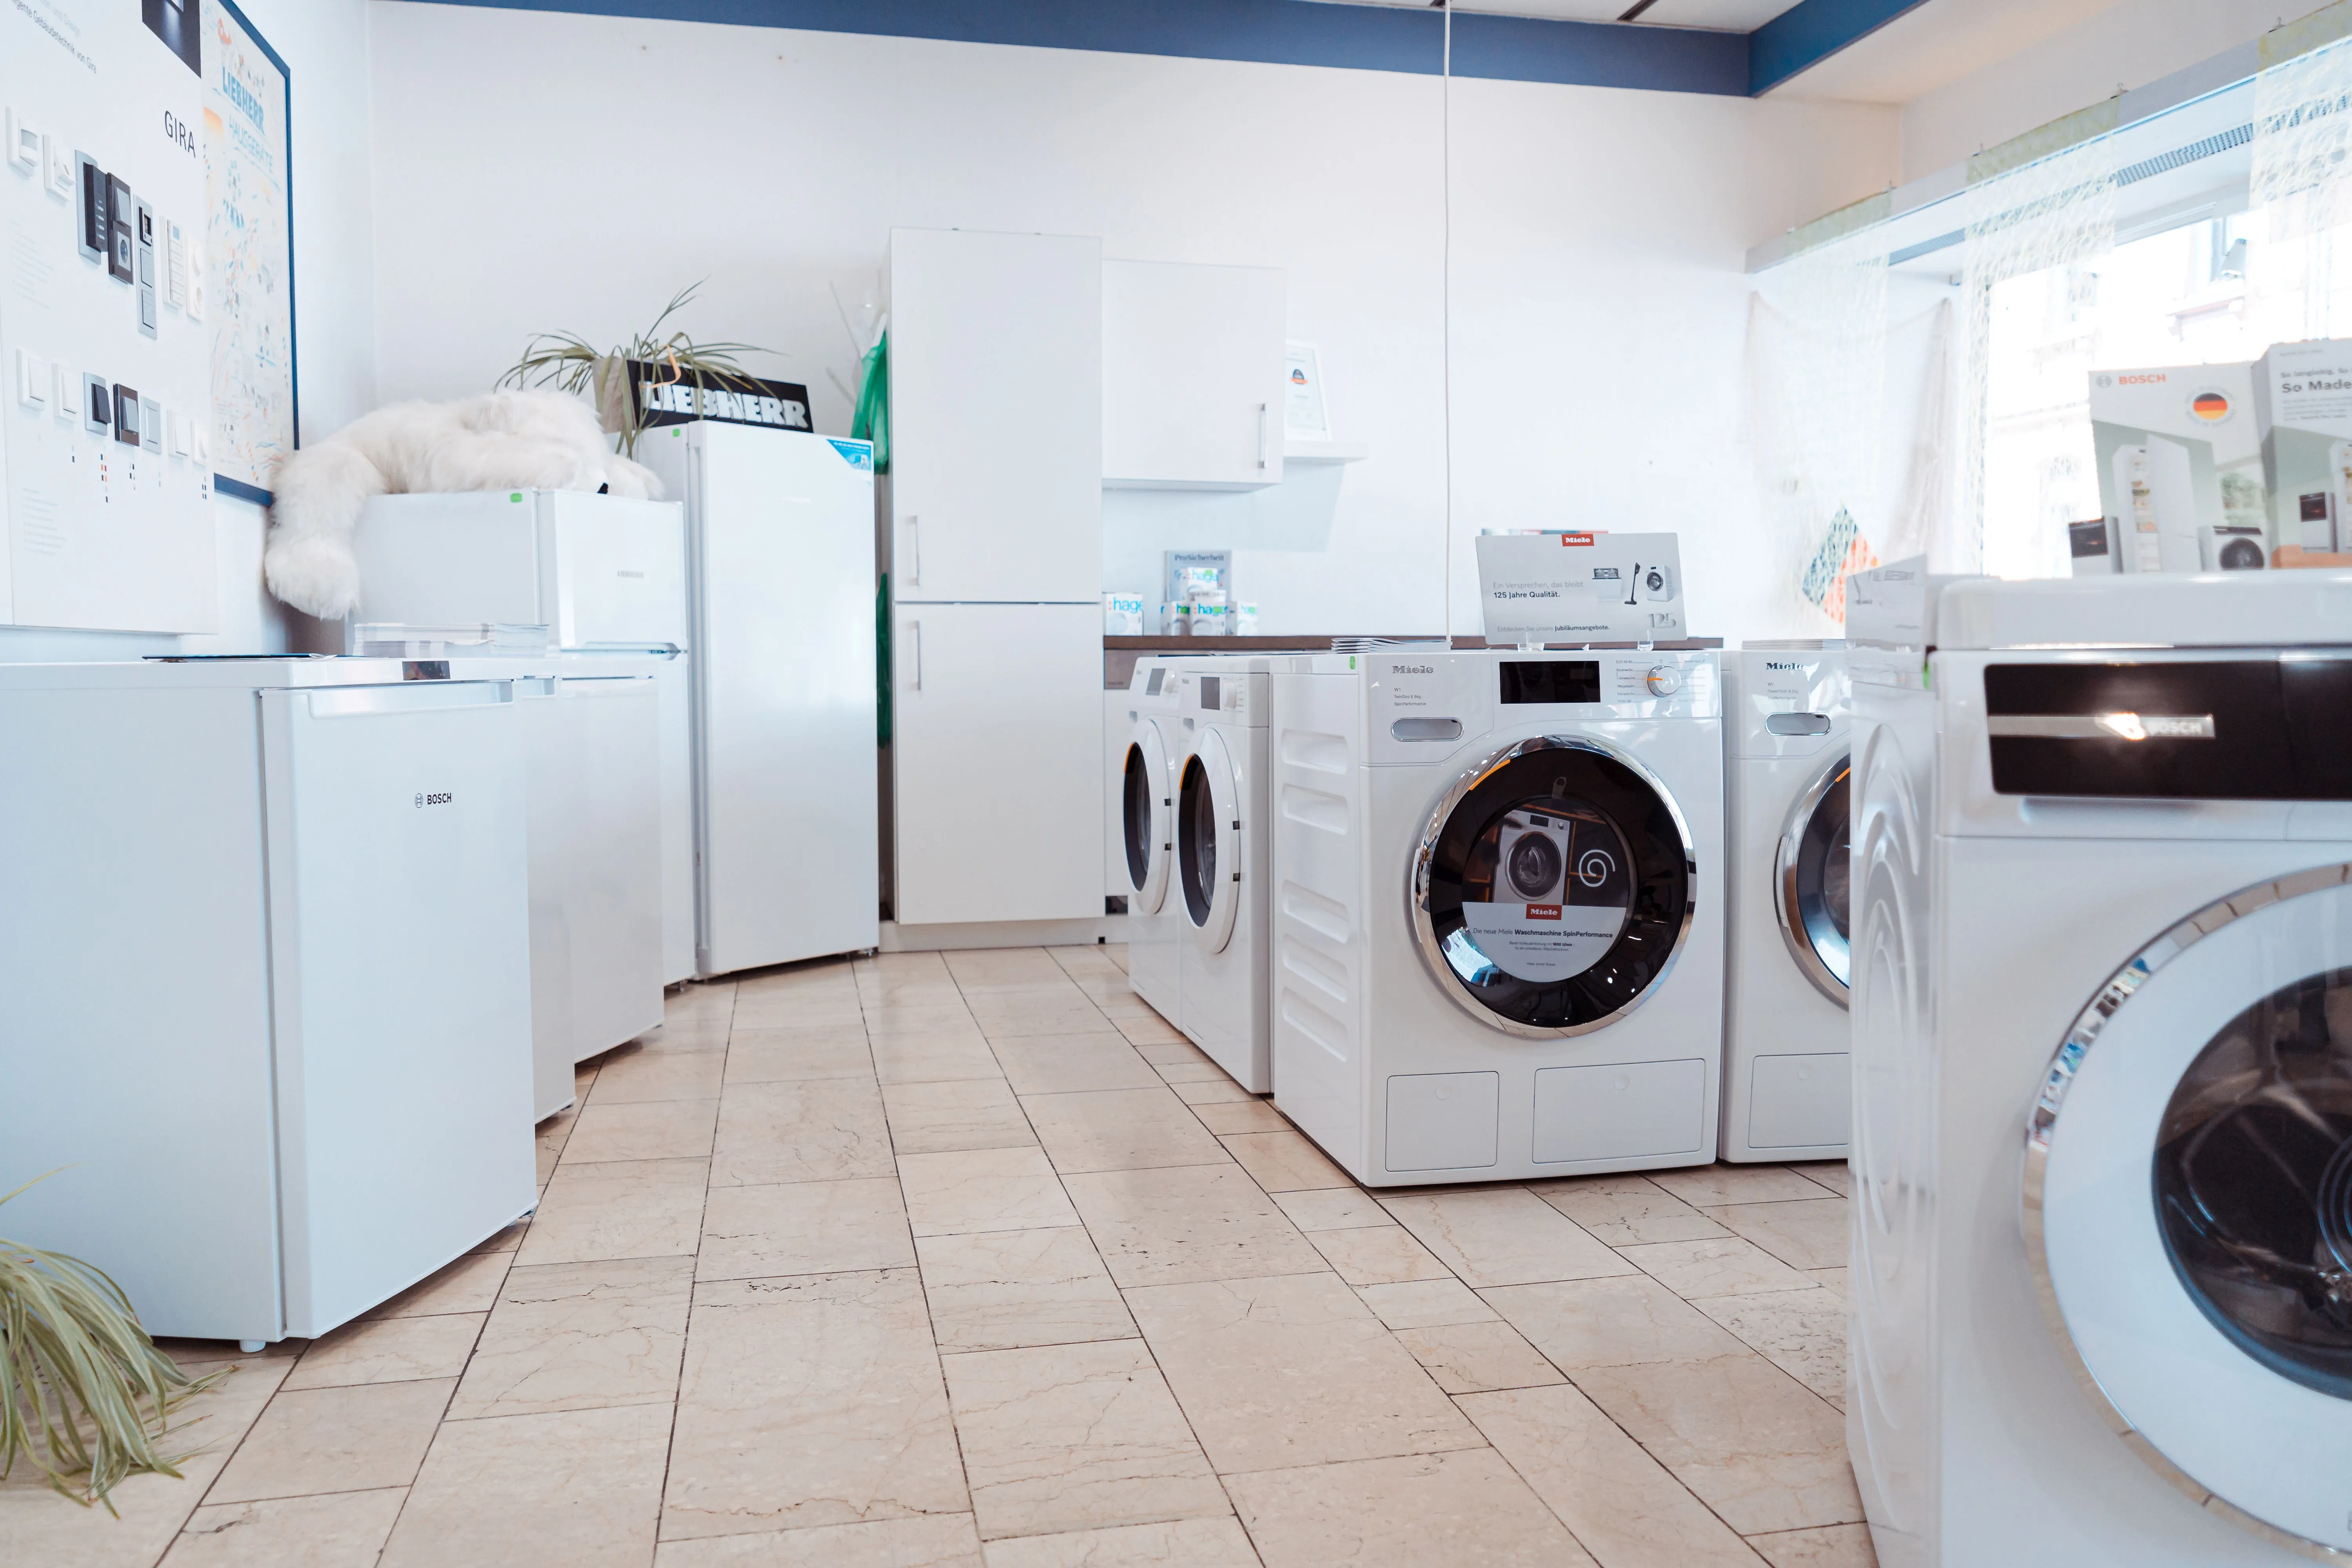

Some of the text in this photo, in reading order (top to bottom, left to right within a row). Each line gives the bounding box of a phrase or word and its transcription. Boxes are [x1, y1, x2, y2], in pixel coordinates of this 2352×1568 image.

[34, 11, 75, 55] Gebäudetechnik
[76, 50, 85, 65] von
[87, 56, 96, 74] Gira
[222, 66, 266, 136] LIEBHERR
[165, 111, 196, 158] GIRA
[2119, 374, 2166, 385] BOSCH
[2282, 379, 2352, 393] So Made
[639, 381, 808, 428] LIEBHERR
[1505, 581, 1549, 590] Versprechen,
[1647, 613, 1676, 628] 125
[427, 792, 452, 805] BOSCH
